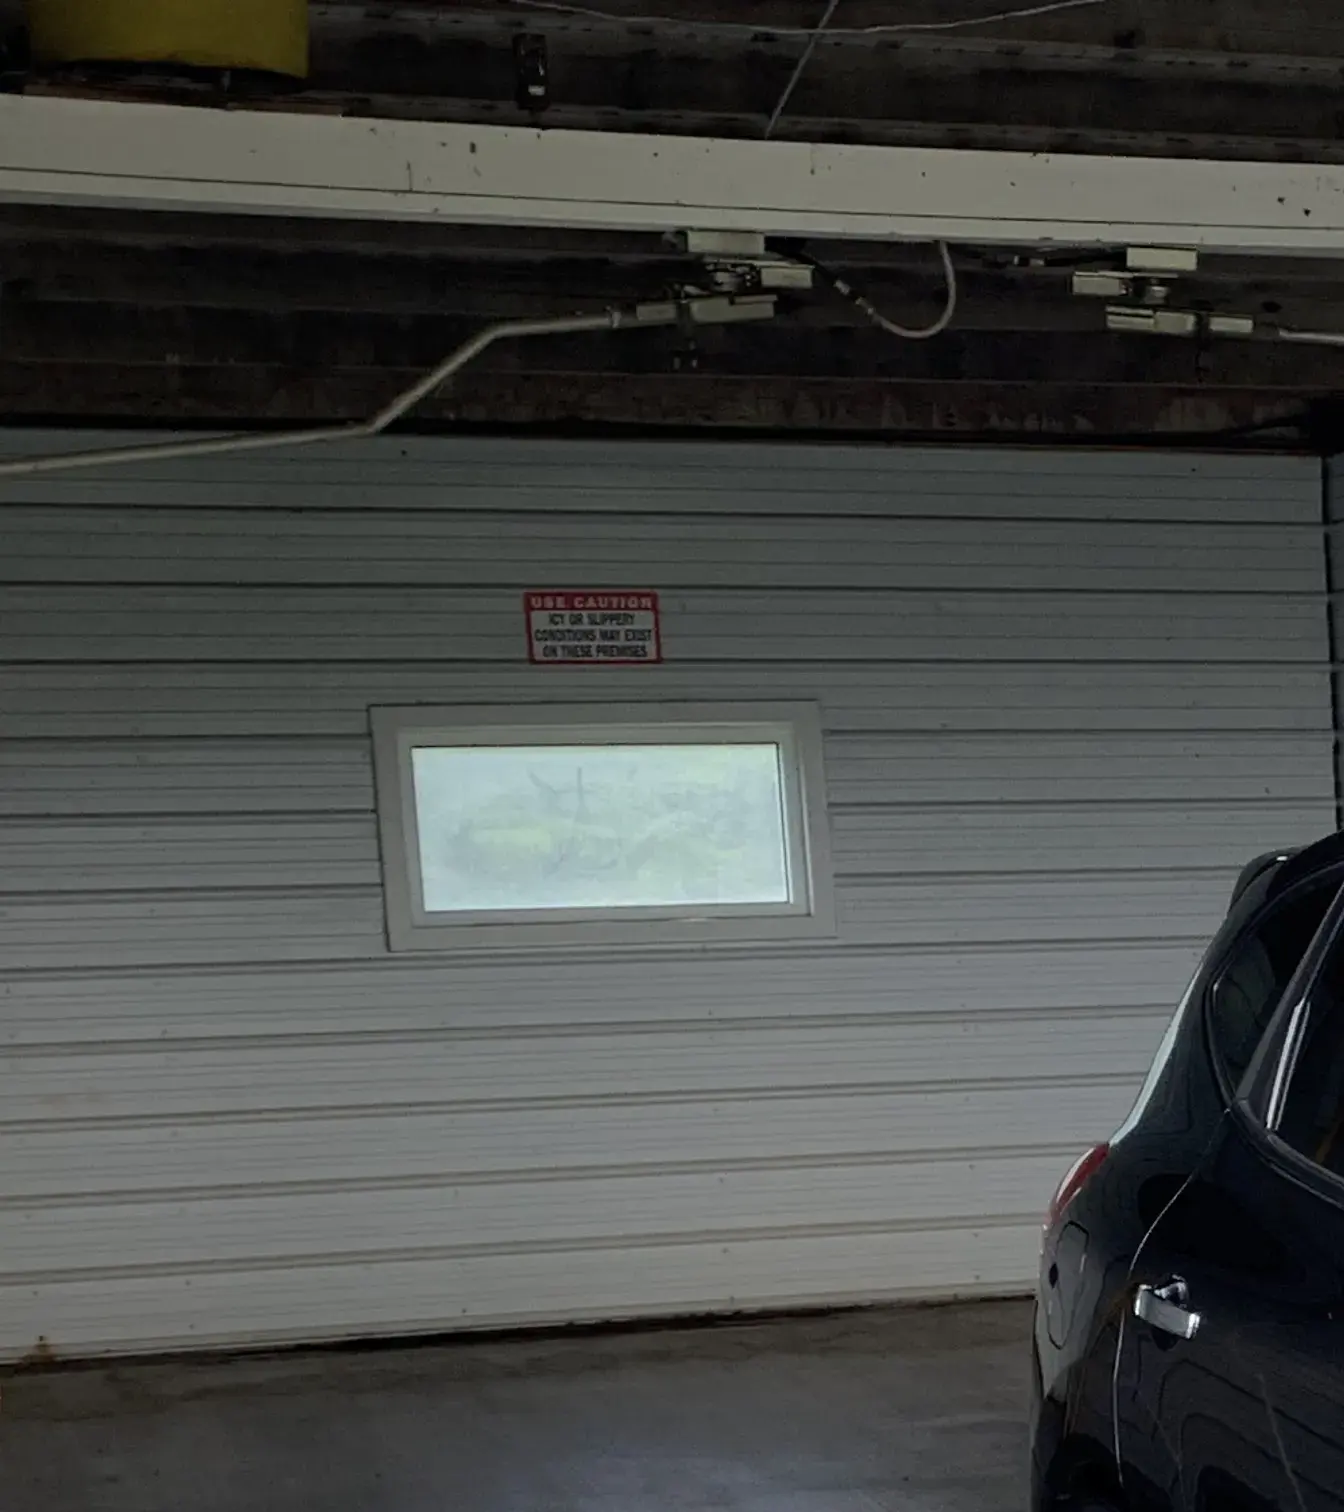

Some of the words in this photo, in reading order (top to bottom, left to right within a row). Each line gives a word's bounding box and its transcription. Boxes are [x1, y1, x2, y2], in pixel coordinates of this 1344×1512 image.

[531, 596, 566, 608] USE
[573, 596, 653, 608] CAUTION
[534, 629, 597, 641] CONDITIONS
[595, 645, 648, 657] PREMISES
